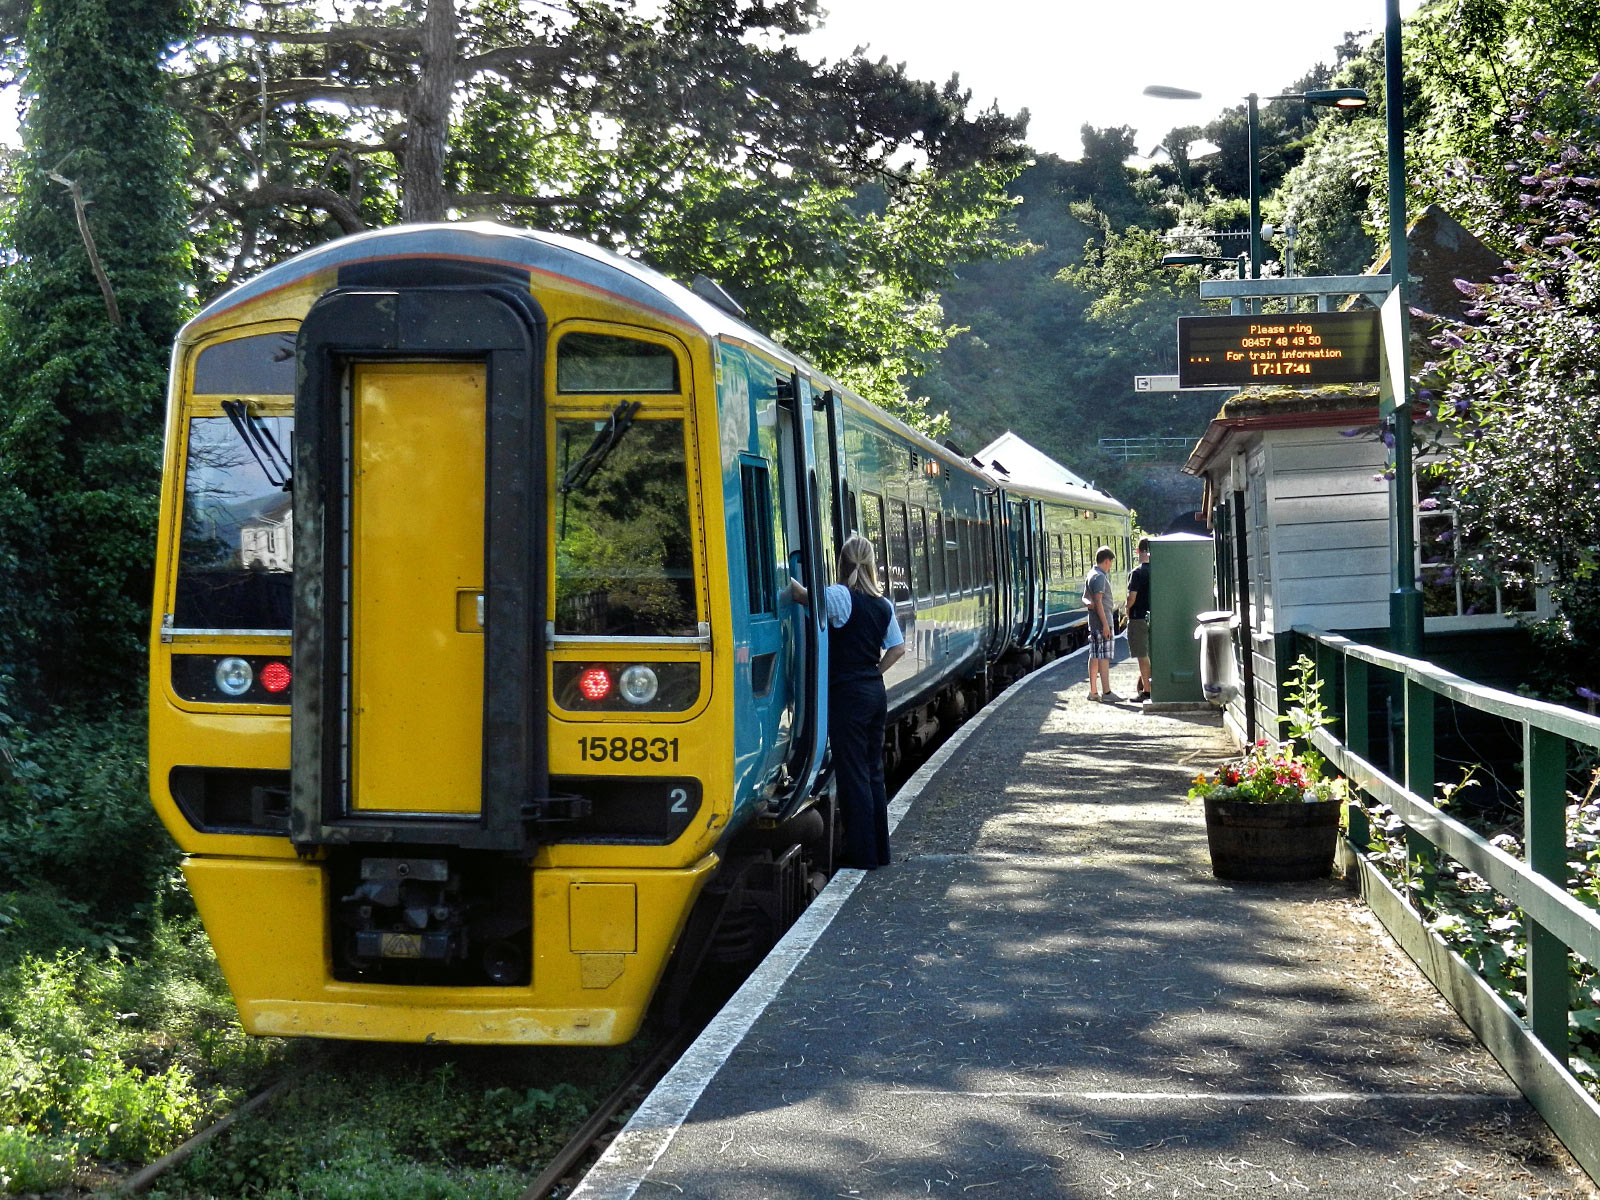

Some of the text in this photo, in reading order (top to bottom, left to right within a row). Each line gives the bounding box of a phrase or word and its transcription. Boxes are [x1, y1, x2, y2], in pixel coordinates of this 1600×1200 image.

[1250, 323, 1313, 335] Please ring
[1241, 336, 1322, 347] 08457 48 49 50
[1226, 351, 1245, 361] For
[1249, 350, 1277, 361] train
[1281, 348, 1342, 360] information
[1252, 362, 1312, 376] 17:17:41
[577, 736, 679, 763] 158831
[670, 788, 688, 813] 2
